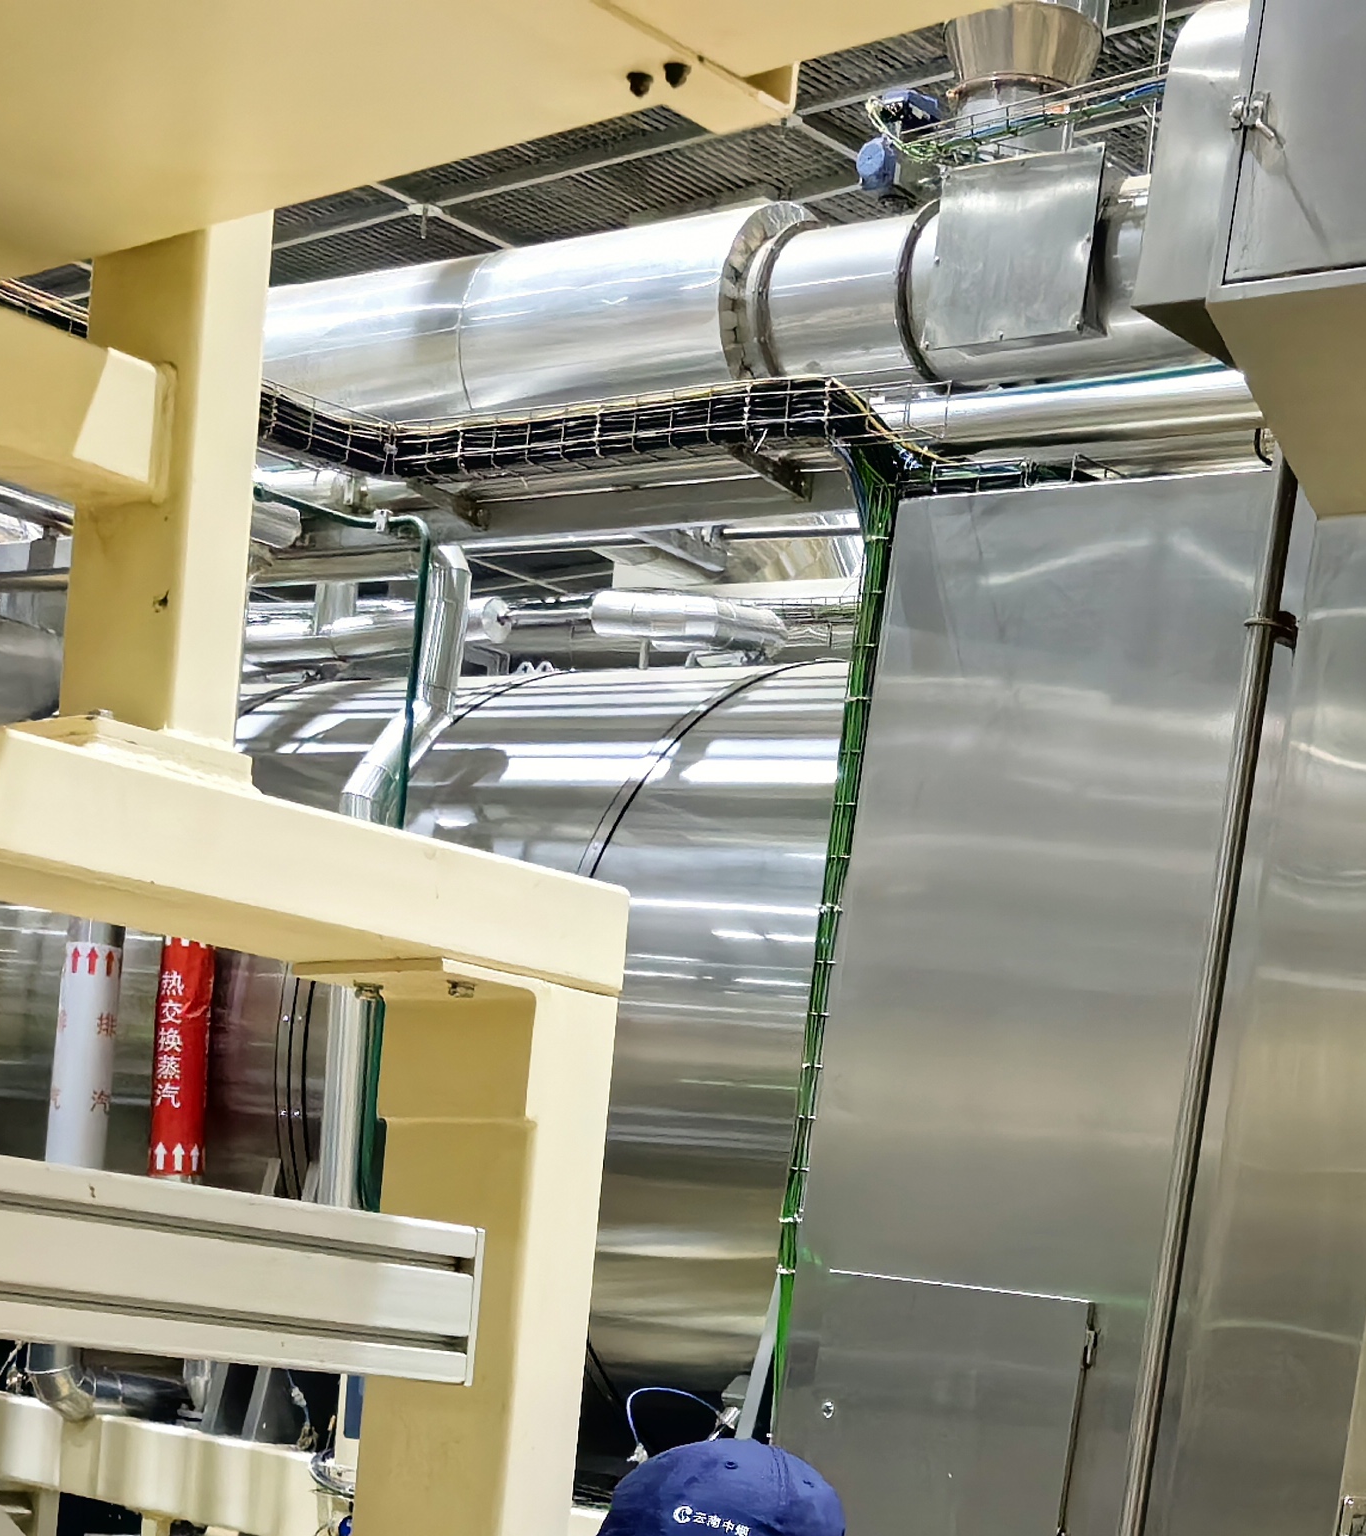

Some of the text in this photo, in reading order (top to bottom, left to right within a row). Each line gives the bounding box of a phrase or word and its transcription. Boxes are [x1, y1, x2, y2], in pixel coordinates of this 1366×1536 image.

[90, 1012, 117, 1115] 排汽
[155, 970, 186, 1109] 热交换蒸汽
